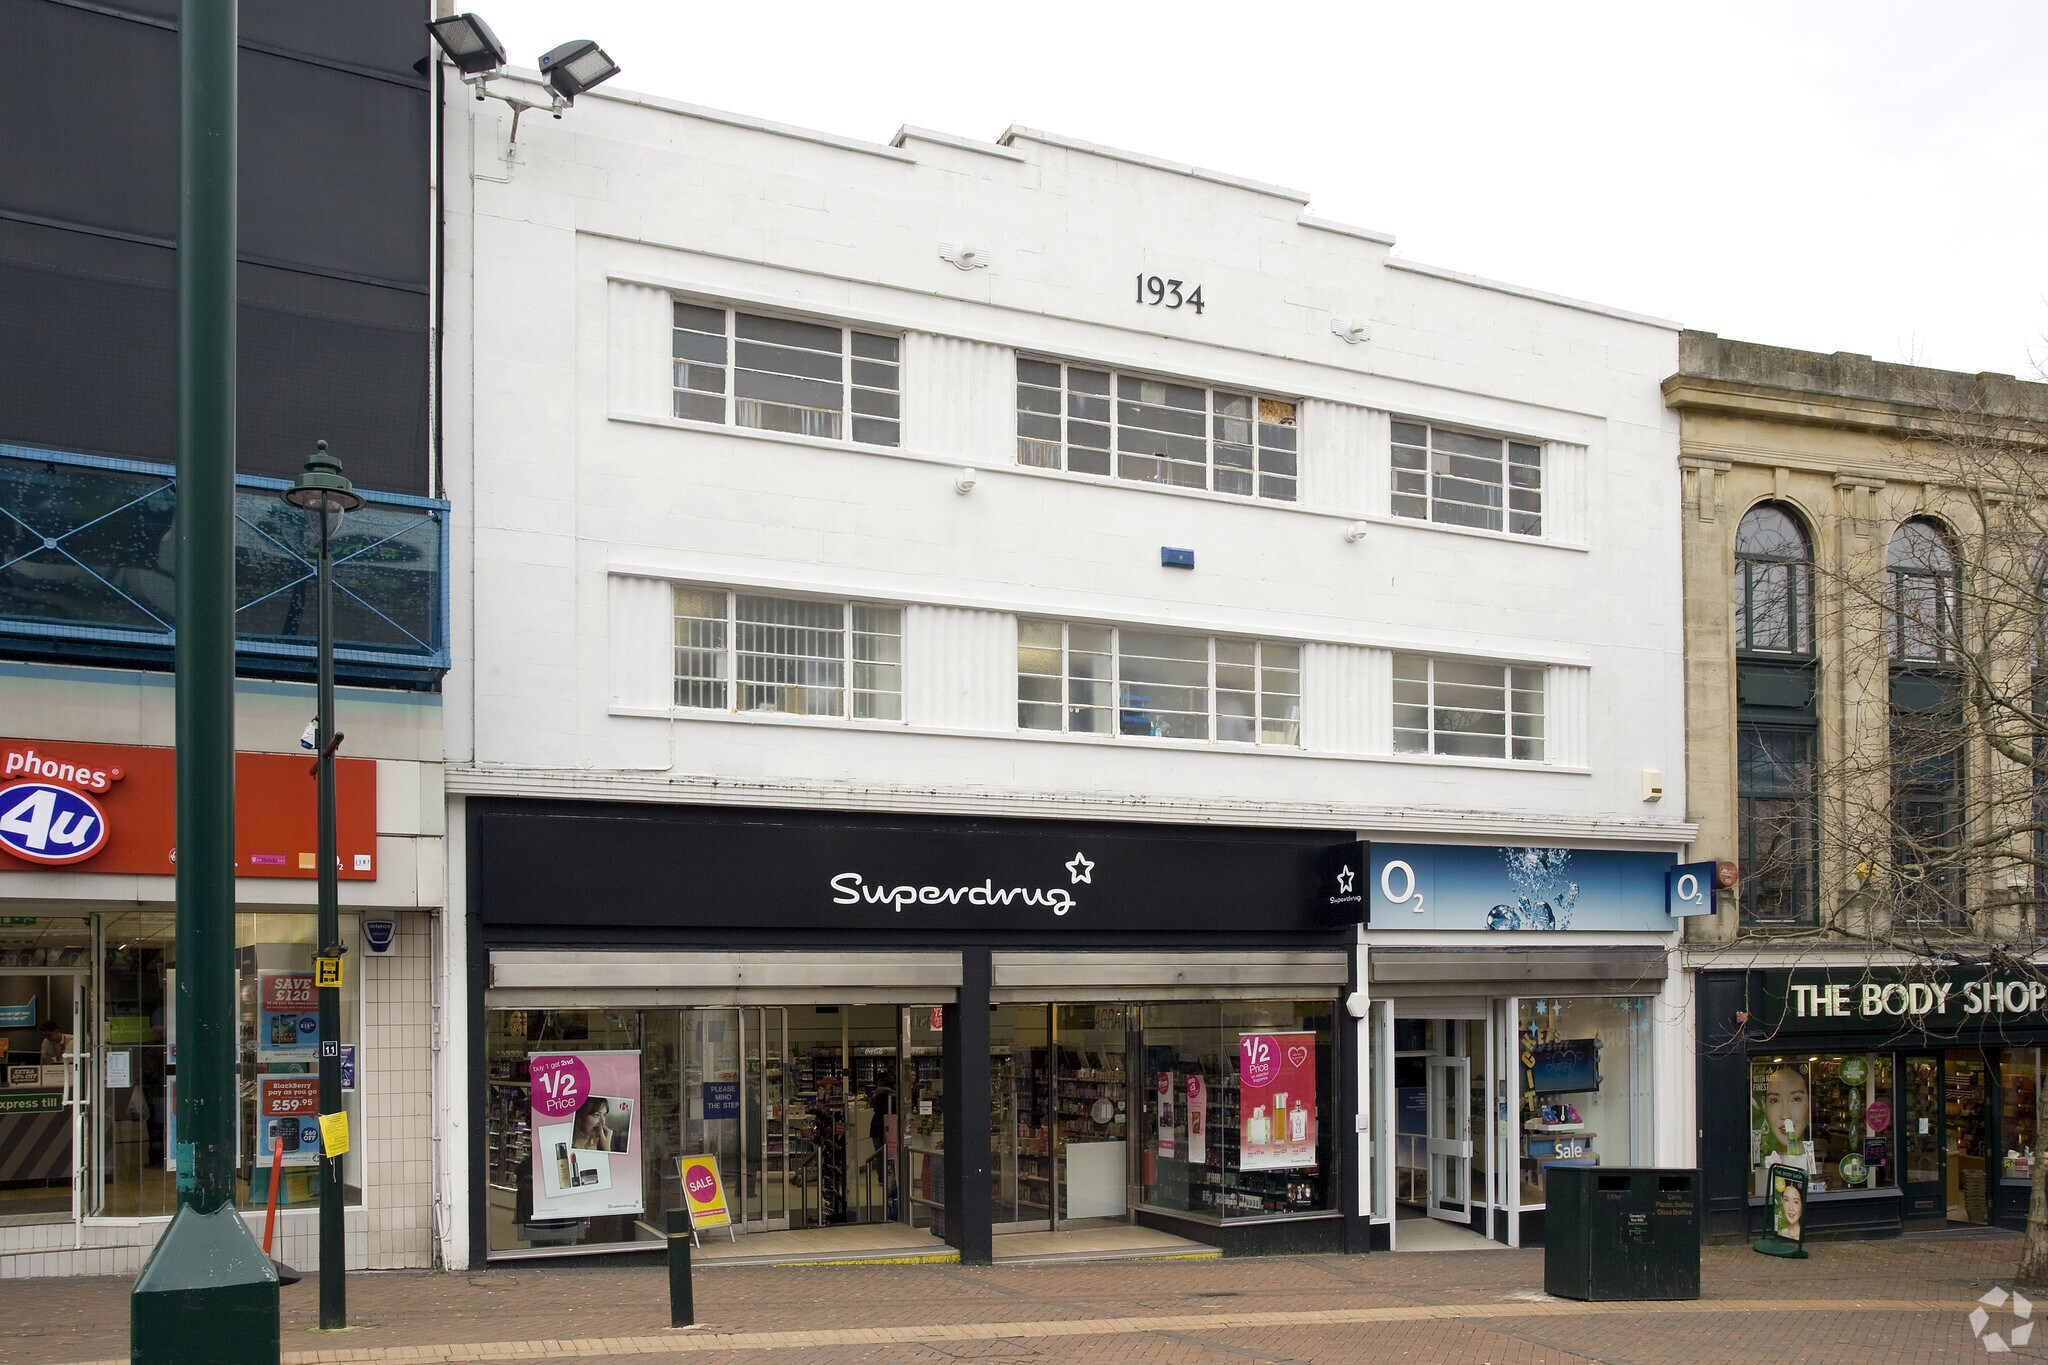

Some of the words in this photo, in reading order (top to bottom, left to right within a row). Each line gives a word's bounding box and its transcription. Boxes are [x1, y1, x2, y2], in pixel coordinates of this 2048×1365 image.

[1136, 273, 1205, 315] 1934
[5, 750, 106, 788] phones
[0, 789, 96, 850] 4u
[1381, 860, 1424, 913] O2
[1677, 874, 1703, 905] O2
[830, 872, 1077, 916] Superdrug
[1329, 895, 1362, 904] Superdrug
[274, 978, 312, 989] SAVE
[275, 990, 310, 1001] £120
[1791, 984, 1850, 1017] THE
[1862, 982, 1953, 1016] BODY
[1963, 981, 2047, 1014] SHOP
[325, 1046, 335, 1054] 11
[1243, 1036, 1271, 1065] 1/2
[532, 1065, 545, 1073] buy
[550, 1061, 561, 1070] get
[560, 1058, 574, 1066] 2nd
[1249, 1063, 1269, 1075] Price
[539, 1070, 578, 1099] 1/2
[1753, 1074, 1765, 1083] WITH
[710, 1085, 736, 1093] PLEASE
[1753, 1083, 1769, 1092] FINEST
[42, 1098, 57, 1107] till
[715, 1093, 732, 1101] MIND
[272, 1098, 313, 1111] £59.95
[546, 1097, 576, 1112] Price
[723, 1101, 740, 1109] STEP
[1555, 1143, 1583, 1159] Sale
[1865, 1147, 1885, 1156] FREE
[689, 1175, 714, 1193] SALE
